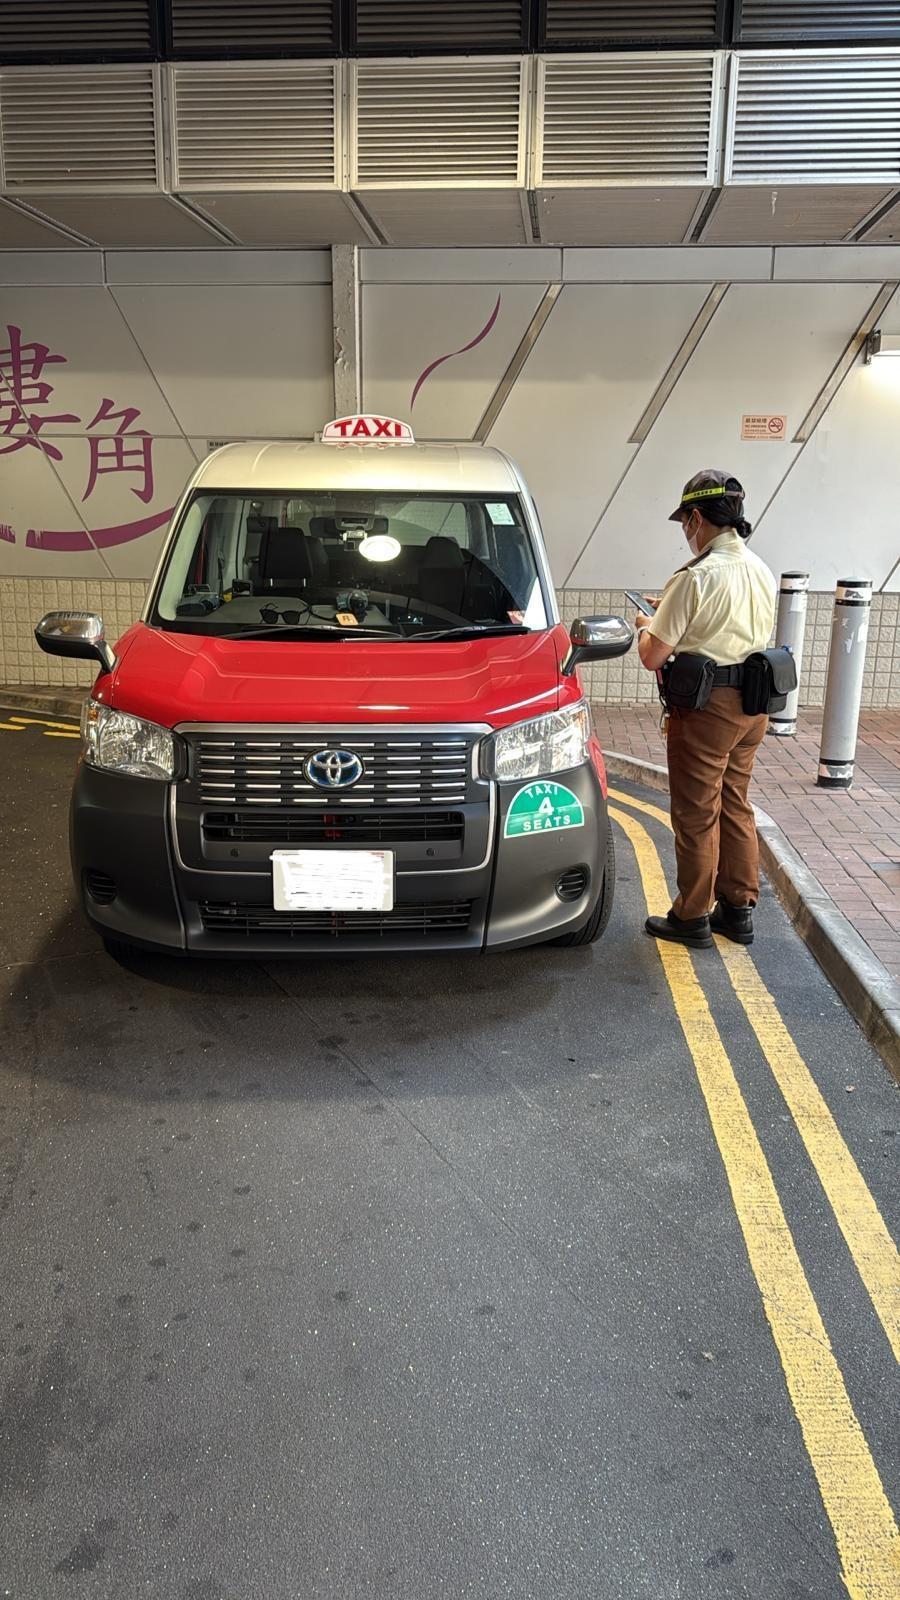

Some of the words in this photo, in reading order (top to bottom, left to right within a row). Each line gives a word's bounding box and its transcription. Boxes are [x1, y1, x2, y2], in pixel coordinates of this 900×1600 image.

[334, 418, 402, 437] TAXI
[525, 784, 558, 799] TAXI
[538, 797, 554, 815] 4
[523, 815, 571, 831] SEATS
